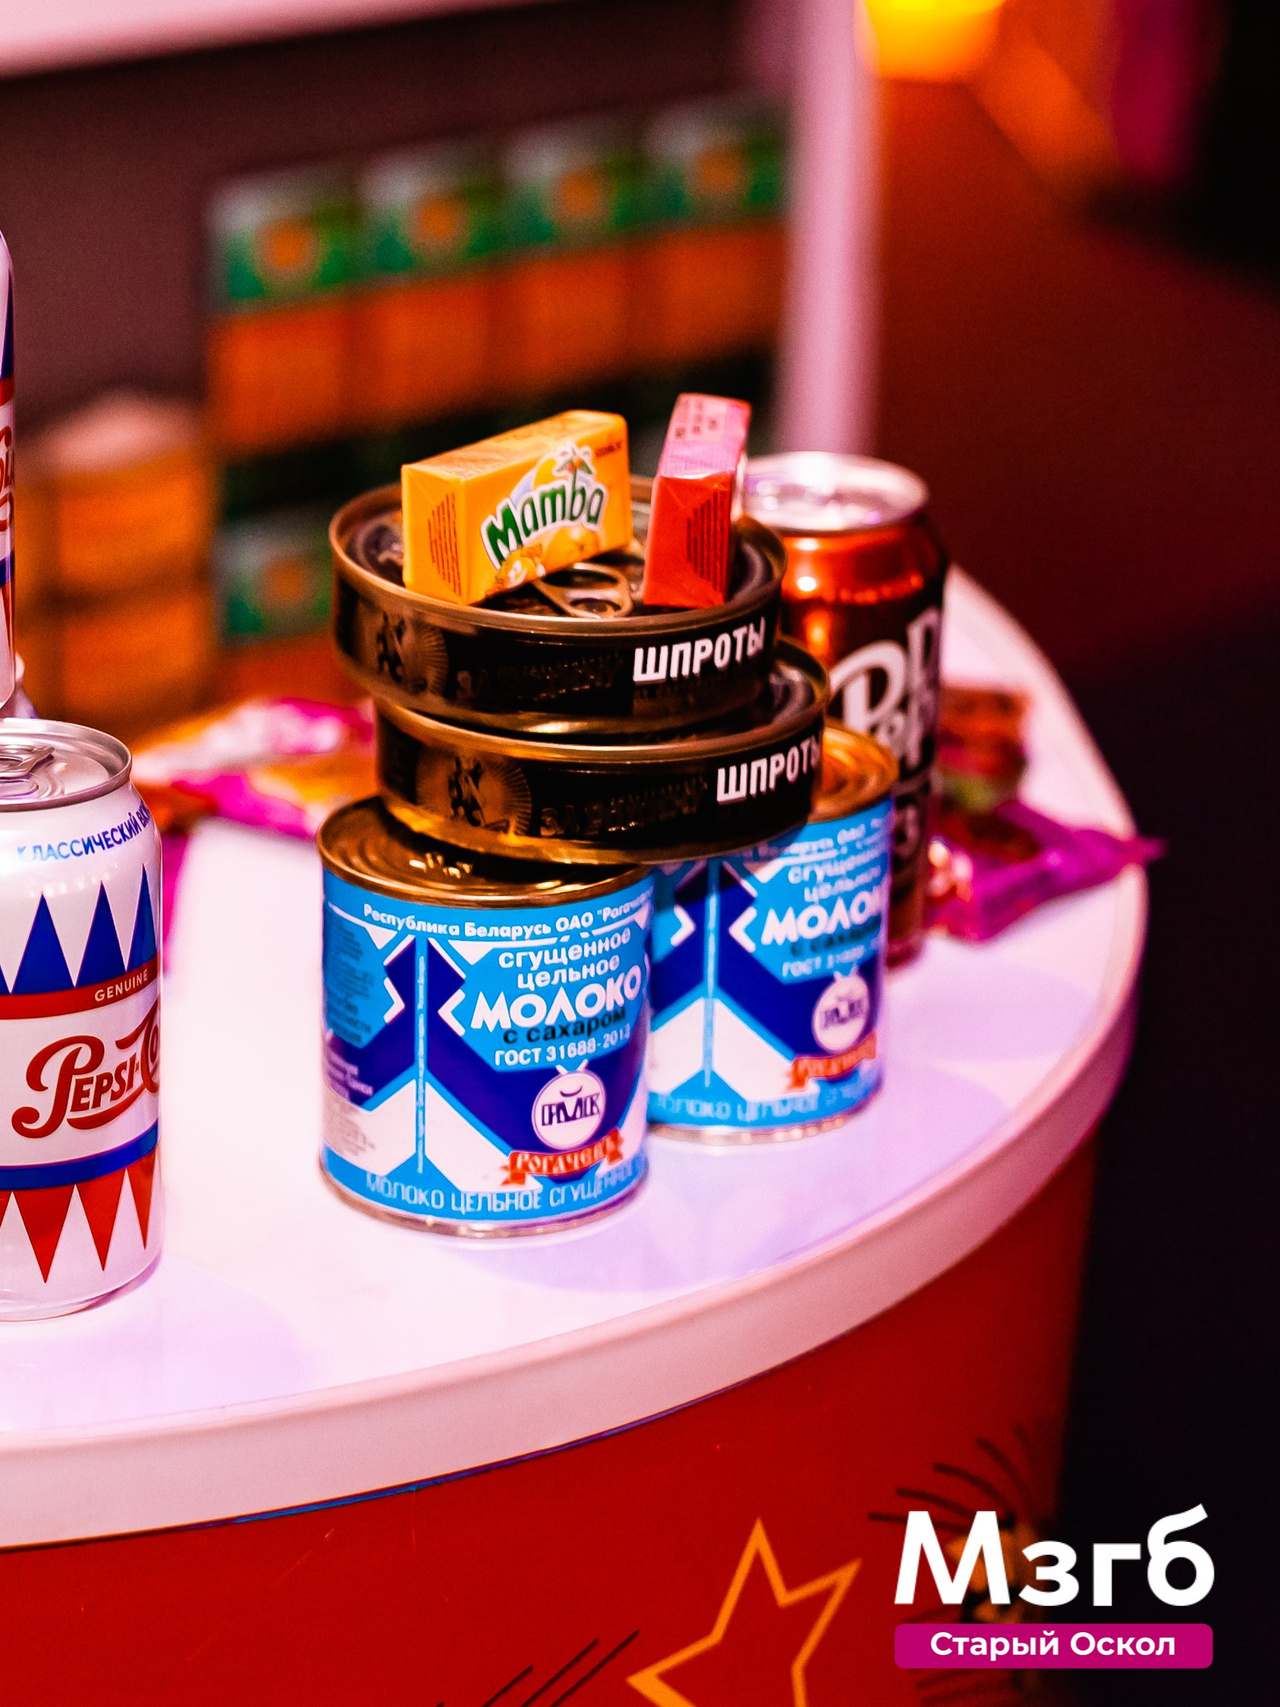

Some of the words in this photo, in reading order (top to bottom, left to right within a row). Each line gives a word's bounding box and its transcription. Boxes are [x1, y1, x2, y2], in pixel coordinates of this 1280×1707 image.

[486, 483, 606, 567] Mamba
[632, 616, 766, 684] ШПРОТЫ
[364, 903, 460, 936] Республика
[464, 922, 552, 940] Беларусь
[555, 911, 595, 933] ОАО
[498, 926, 631, 972] сгущенное
[94, 971, 148, 1002] GENUINE
[517, 954, 620, 991] цельное
[470, 964, 642, 1032] МОЛОКО
[503, 1028, 518, 1044] с
[526, 1007, 626, 1043] сахаром
[494, 1047, 542, 1067] ГОСТ
[451, 1190, 543, 1215] ЦЕЛЬНОЕ
